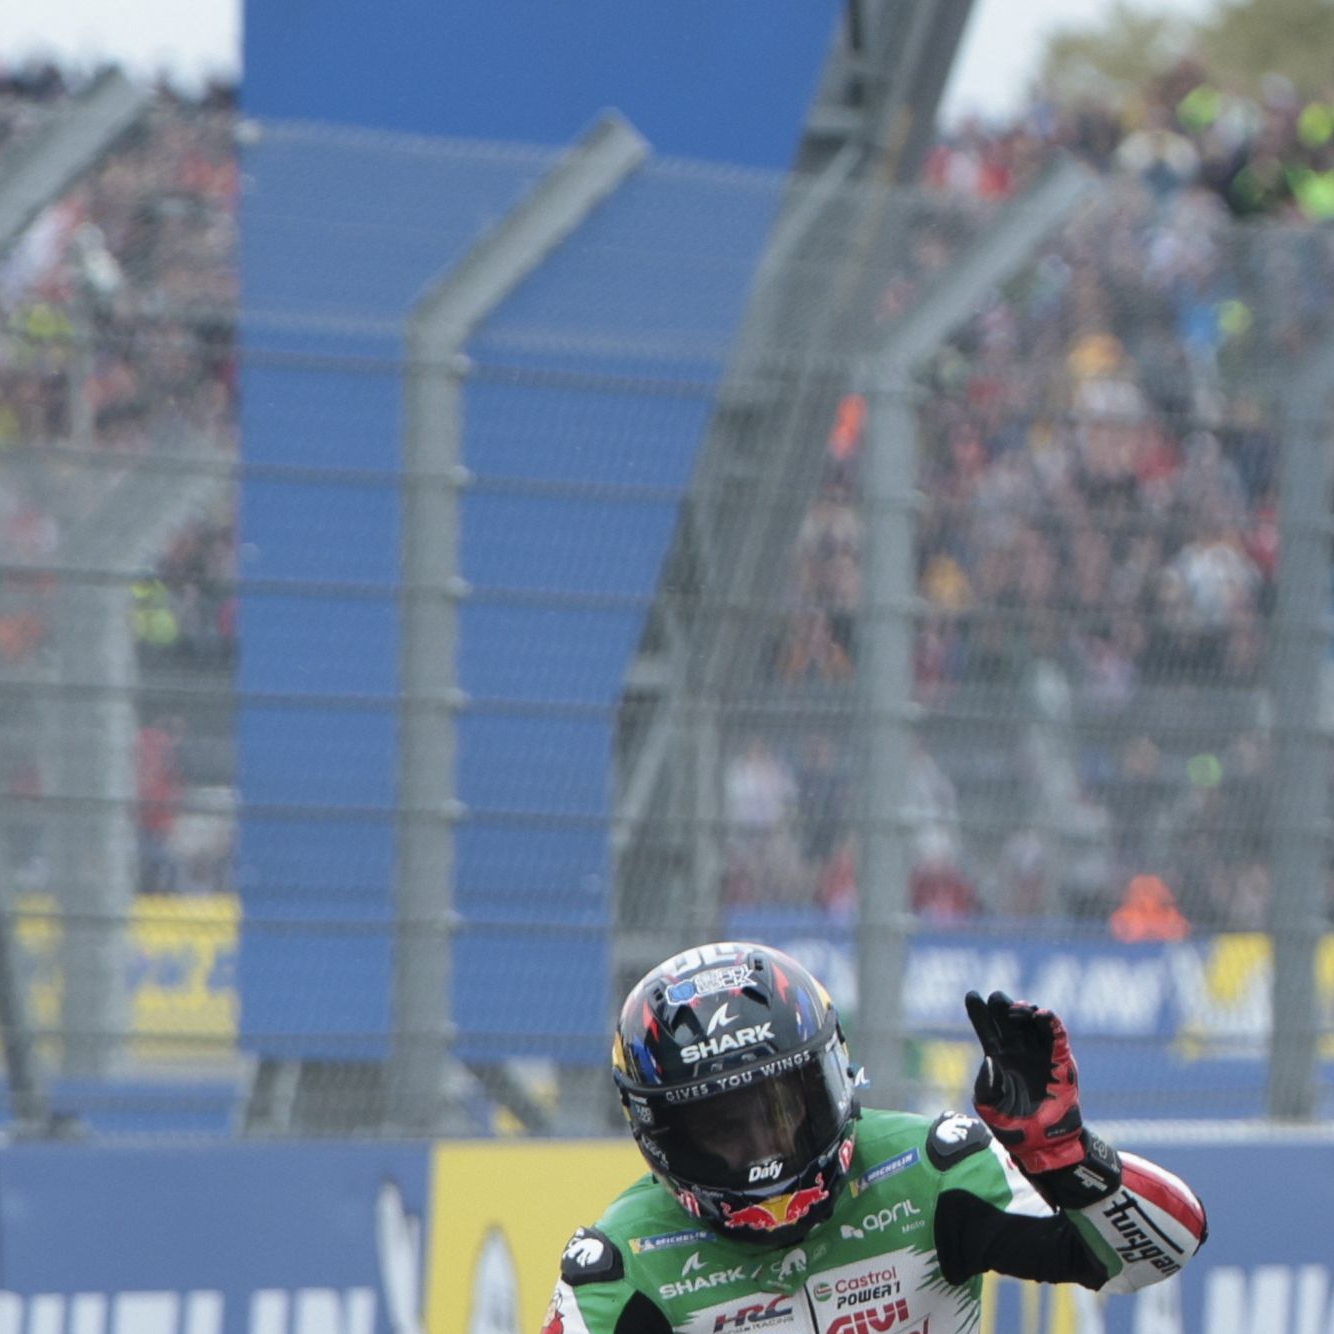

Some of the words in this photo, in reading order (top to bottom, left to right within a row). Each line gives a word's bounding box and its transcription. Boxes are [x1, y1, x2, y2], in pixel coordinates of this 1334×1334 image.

[680, 1022, 775, 1063] SHARK
[664, 1084, 709, 1102] GIVES
[716, 1072, 753, 1090] YOU
[749, 1161, 783, 1183] Dafy
[868, 1153, 913, 1182] MICHELIN
[655, 1231, 707, 1246] MICHELIN
[659, 1266, 747, 1300] SHARK
[835, 1266, 897, 1294] Castrol
[713, 1295, 793, 1333] HRC
